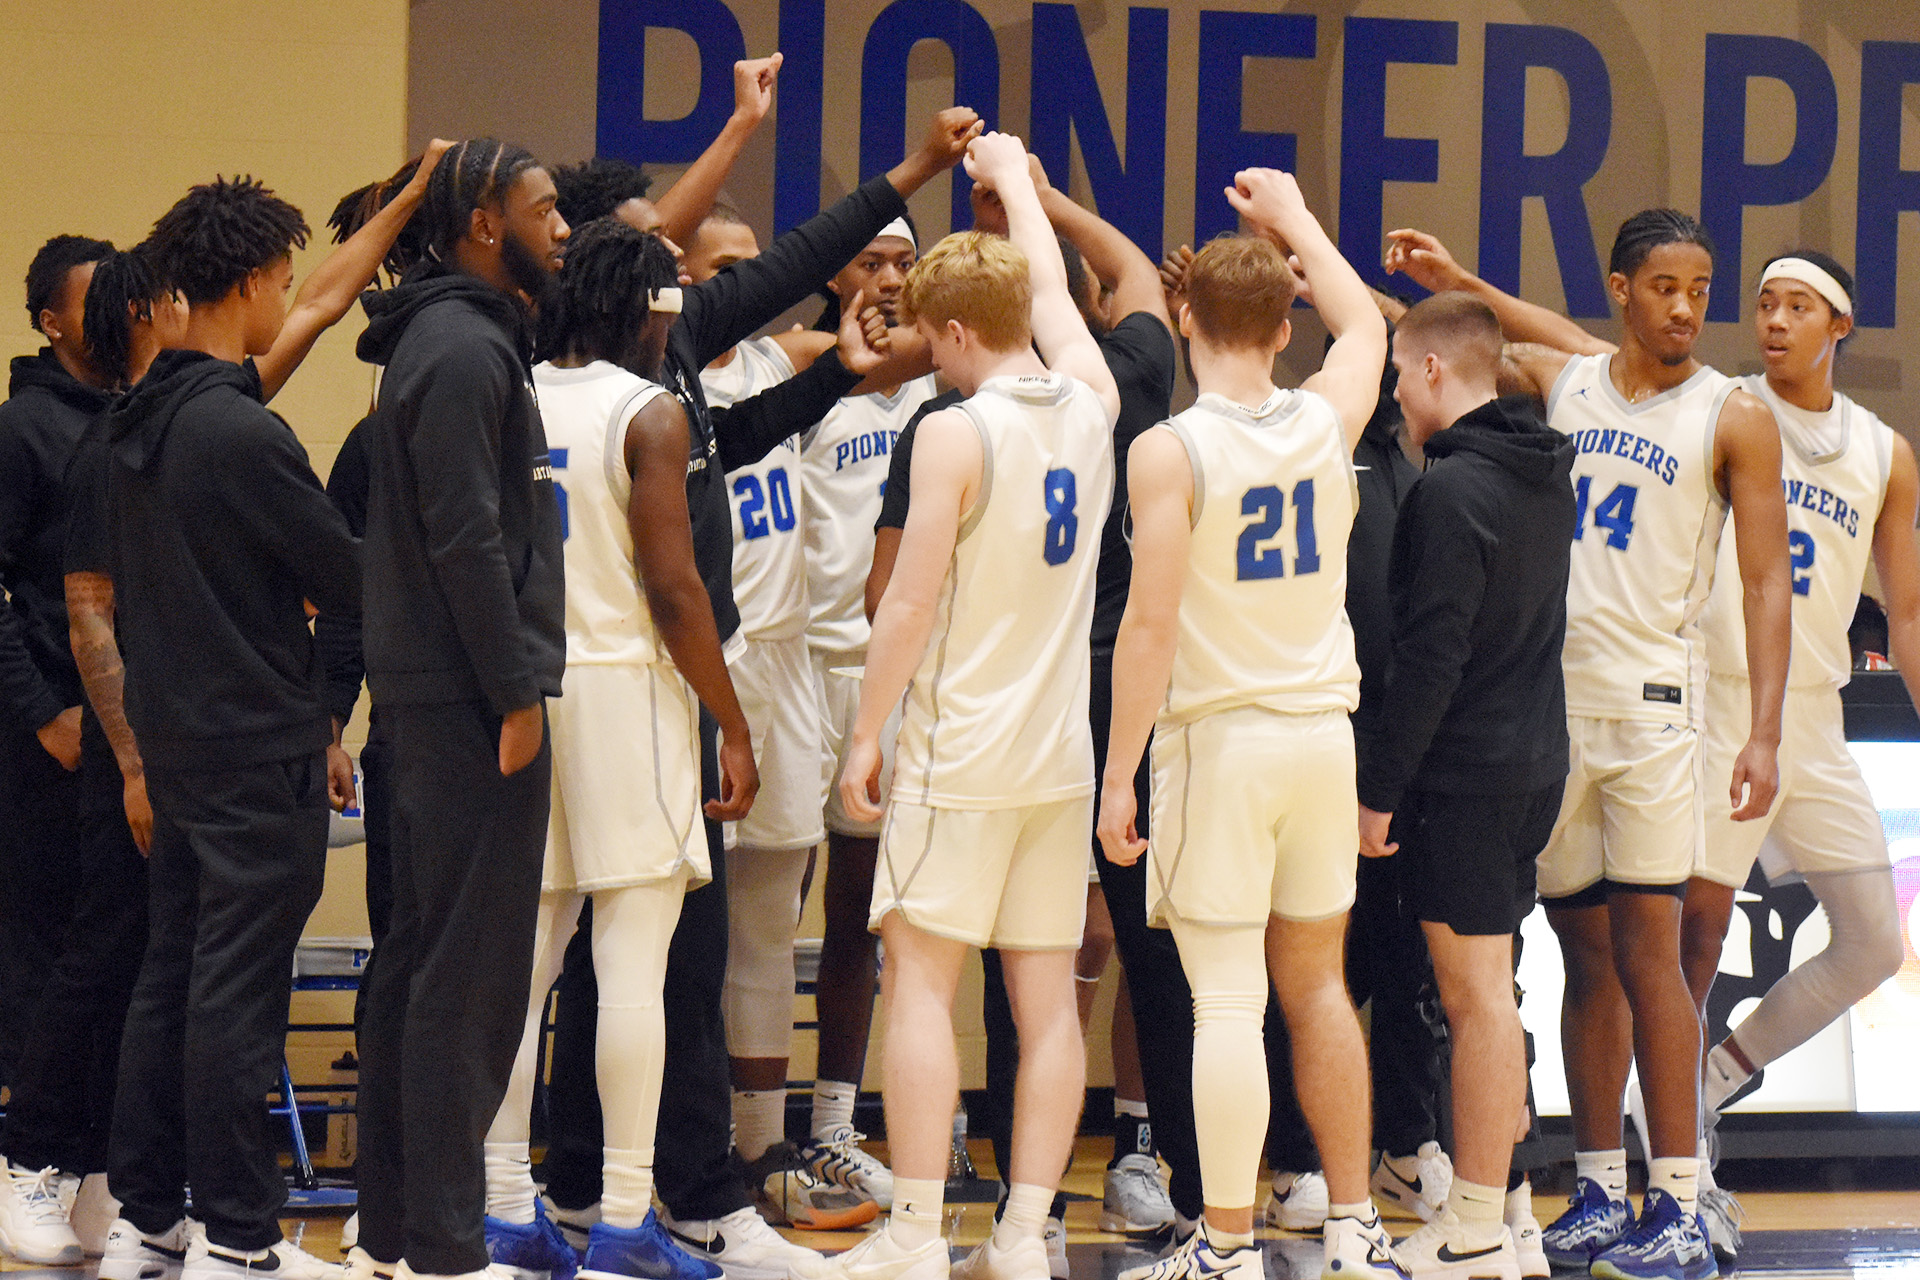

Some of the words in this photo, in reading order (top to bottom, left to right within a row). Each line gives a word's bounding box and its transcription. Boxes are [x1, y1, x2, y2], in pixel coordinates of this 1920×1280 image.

[594, 0, 1612, 319] PIONEER
[836, 430, 901, 471] PION
[1567, 429, 1679, 486] IONEERS
[733, 467, 796, 540] 20
[1043, 466, 1078, 567] 8
[1235, 477, 1320, 583] 21
[1573, 474, 1640, 551] 14
[1781, 479, 1859, 538] NEERS
